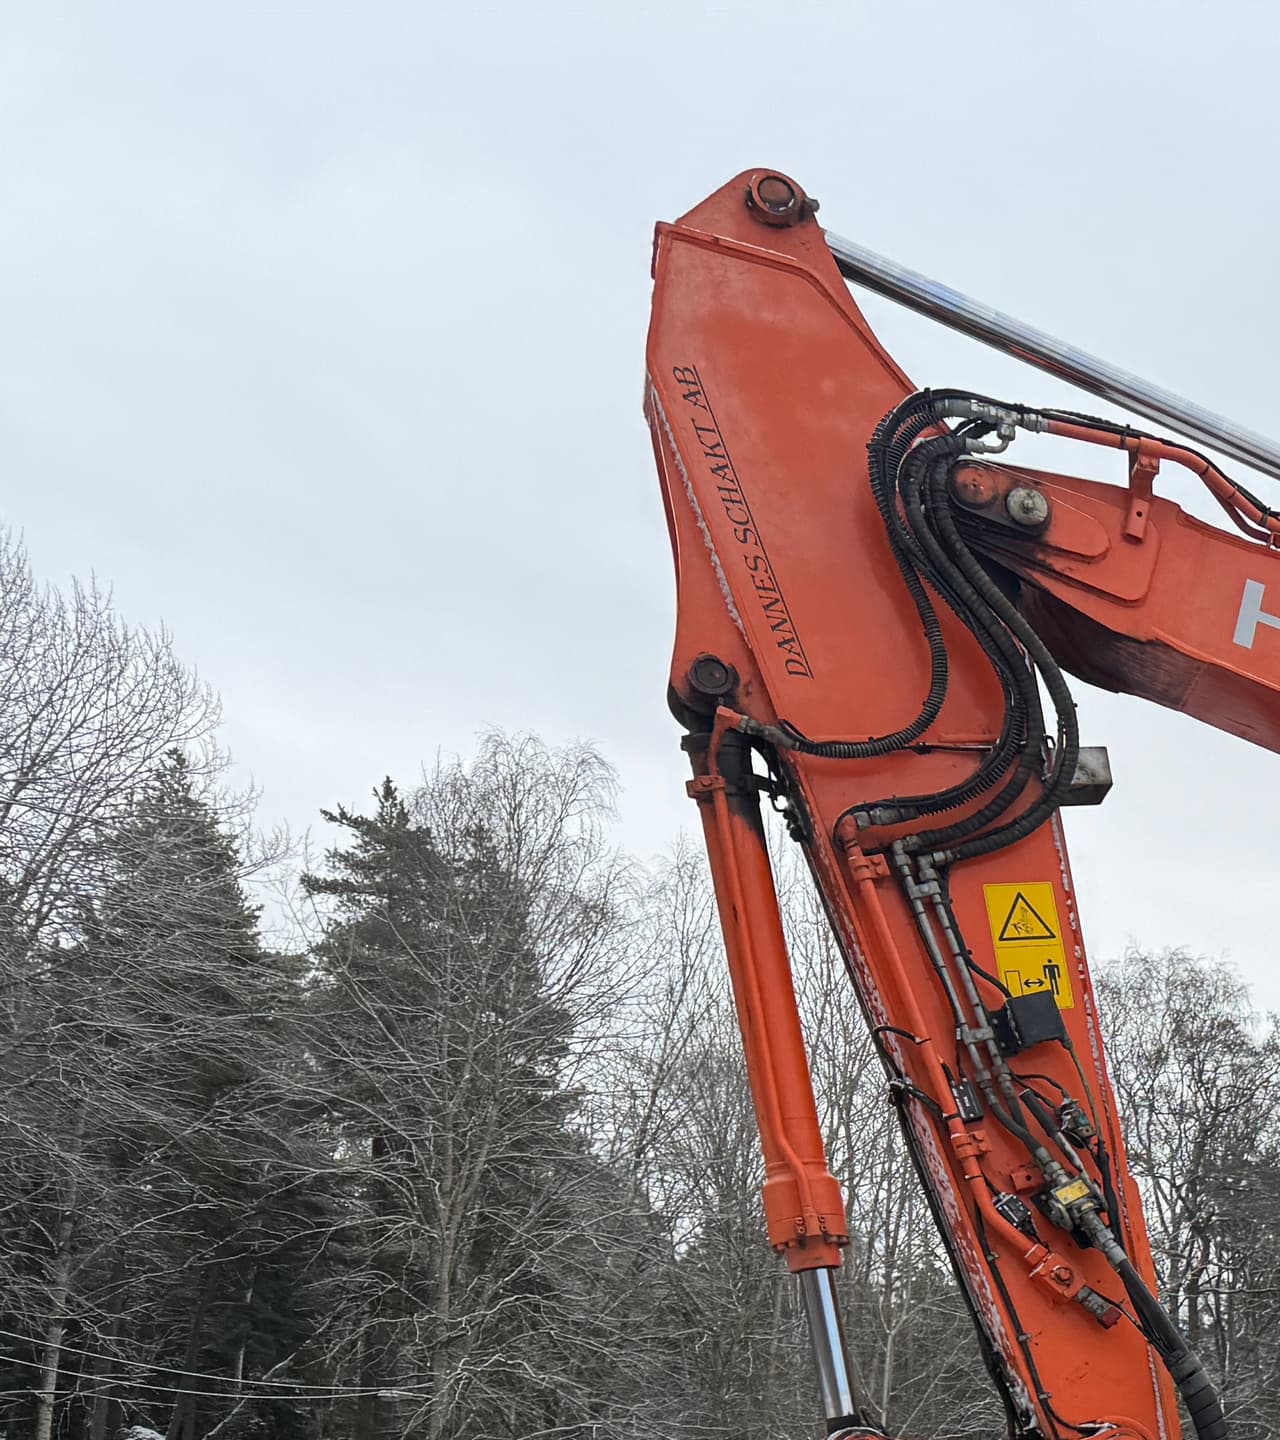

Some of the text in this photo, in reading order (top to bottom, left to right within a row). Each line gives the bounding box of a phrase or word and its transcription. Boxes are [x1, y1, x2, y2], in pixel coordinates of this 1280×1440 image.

[672, 364, 814, 679] DANNES SCHAKT AB
